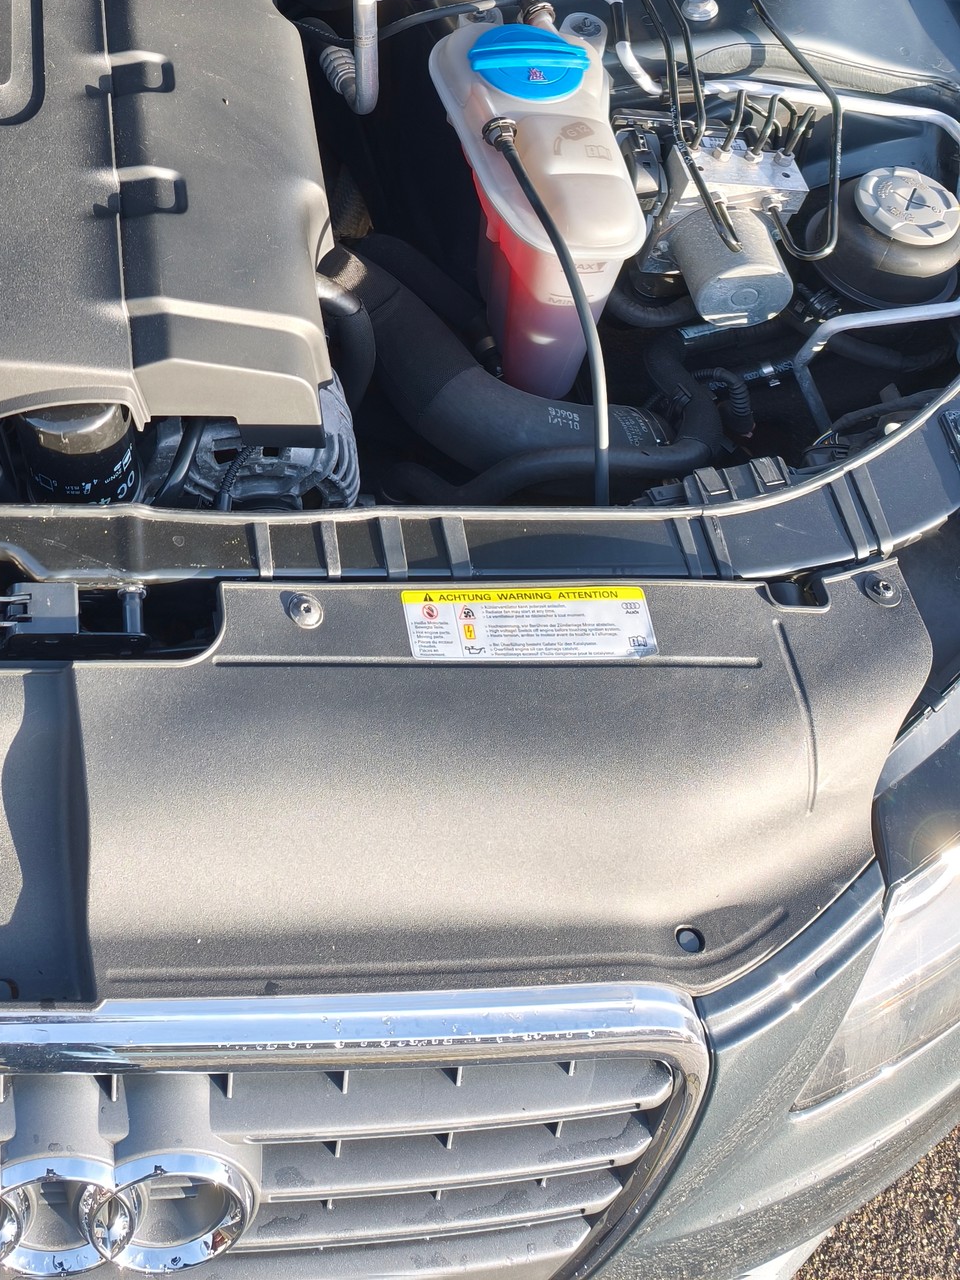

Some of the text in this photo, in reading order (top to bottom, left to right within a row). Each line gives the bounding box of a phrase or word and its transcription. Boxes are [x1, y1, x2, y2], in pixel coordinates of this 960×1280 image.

[438, 590, 619, 602] ACHTUNG WARNING ATTENTION
